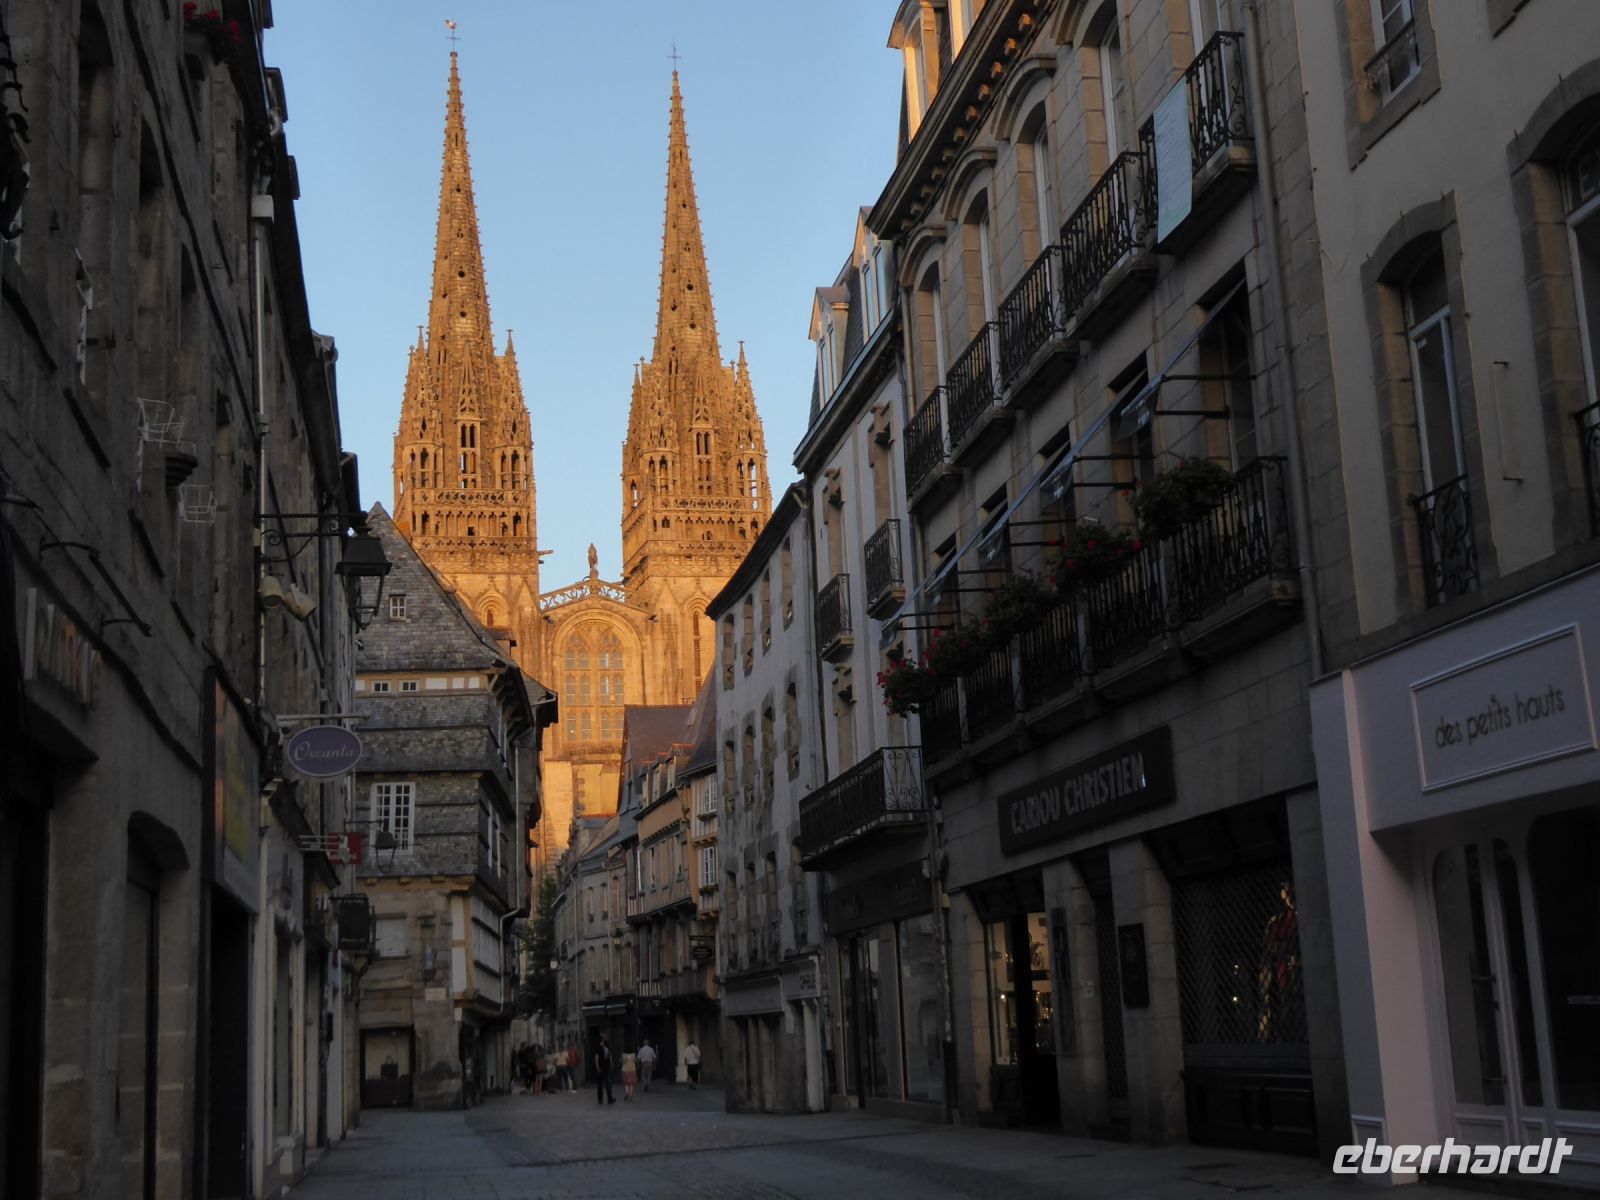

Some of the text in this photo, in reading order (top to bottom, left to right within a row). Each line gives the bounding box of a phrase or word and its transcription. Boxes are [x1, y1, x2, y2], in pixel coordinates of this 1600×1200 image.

[1435, 684, 1565, 748] des petits hauts
[1010, 752, 1147, 835] CARIOU CHRISTIEN
